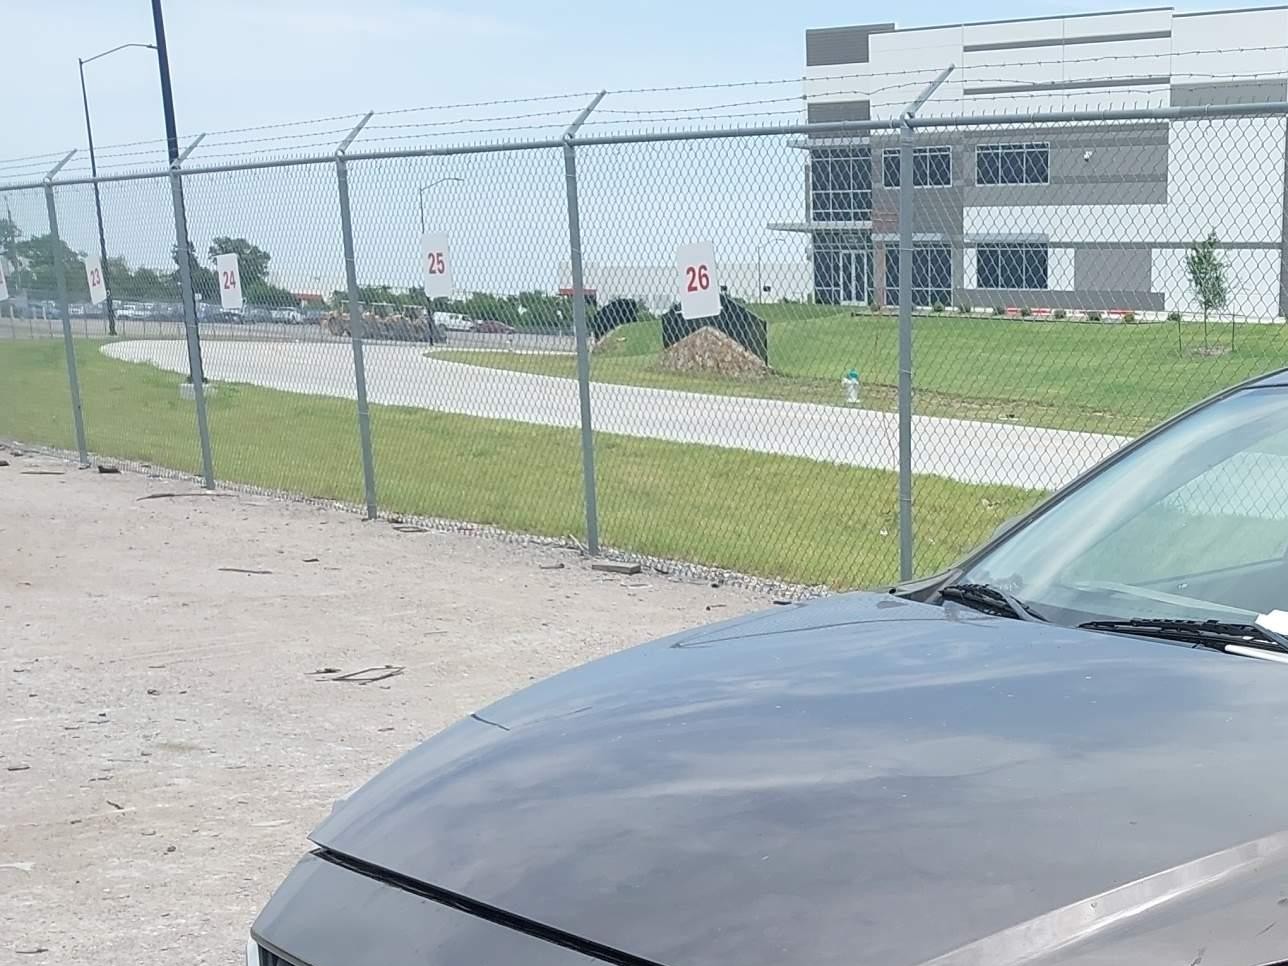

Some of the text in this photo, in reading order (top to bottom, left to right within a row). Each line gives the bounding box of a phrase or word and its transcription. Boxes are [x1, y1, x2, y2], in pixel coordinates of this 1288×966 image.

[427, 252, 445, 274] 25
[90, 267, 102, 288] 23
[222, 271, 237, 290] 24
[685, 264, 710, 292] 26
